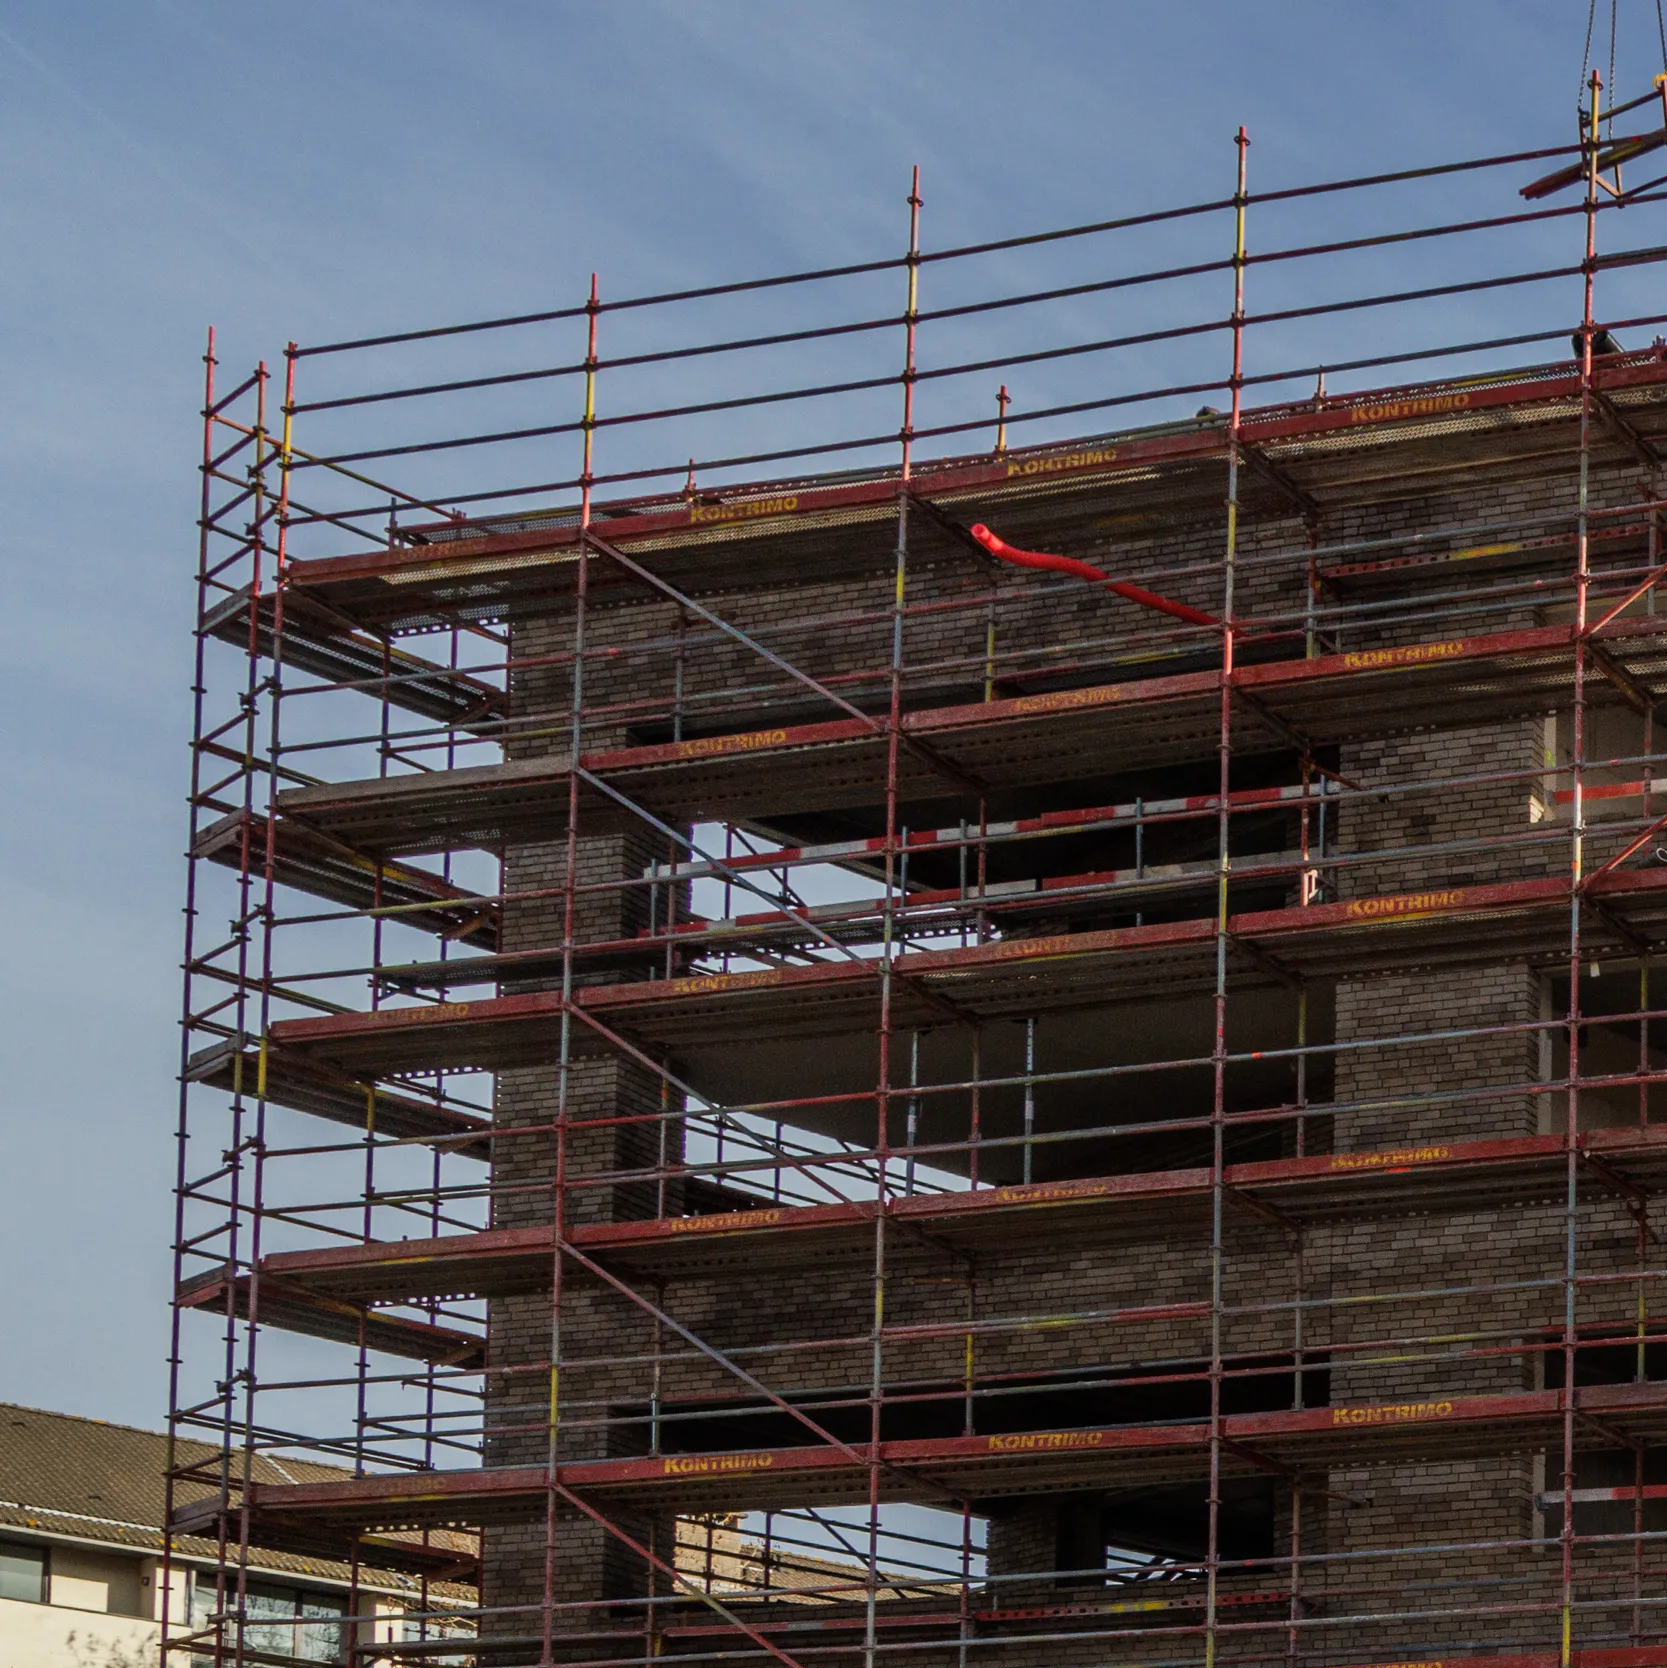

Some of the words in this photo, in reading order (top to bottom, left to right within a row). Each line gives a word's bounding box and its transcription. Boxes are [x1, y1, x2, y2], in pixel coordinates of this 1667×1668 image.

[1351, 394, 1469, 423] KONTRIMO
[1006, 448, 1118, 478] KONTRIMO
[690, 497, 798, 522] KONTRIMO
[678, 730, 786, 757] KONTRIMO
[1346, 891, 1465, 916] KONTRIMO
[670, 1209, 780, 1233] KONTRIMO
[1334, 1401, 1452, 1424] KONTRIMO
[989, 1431, 1102, 1450] KONTRIMO
[664, 1453, 772, 1473] KONTRIMO
